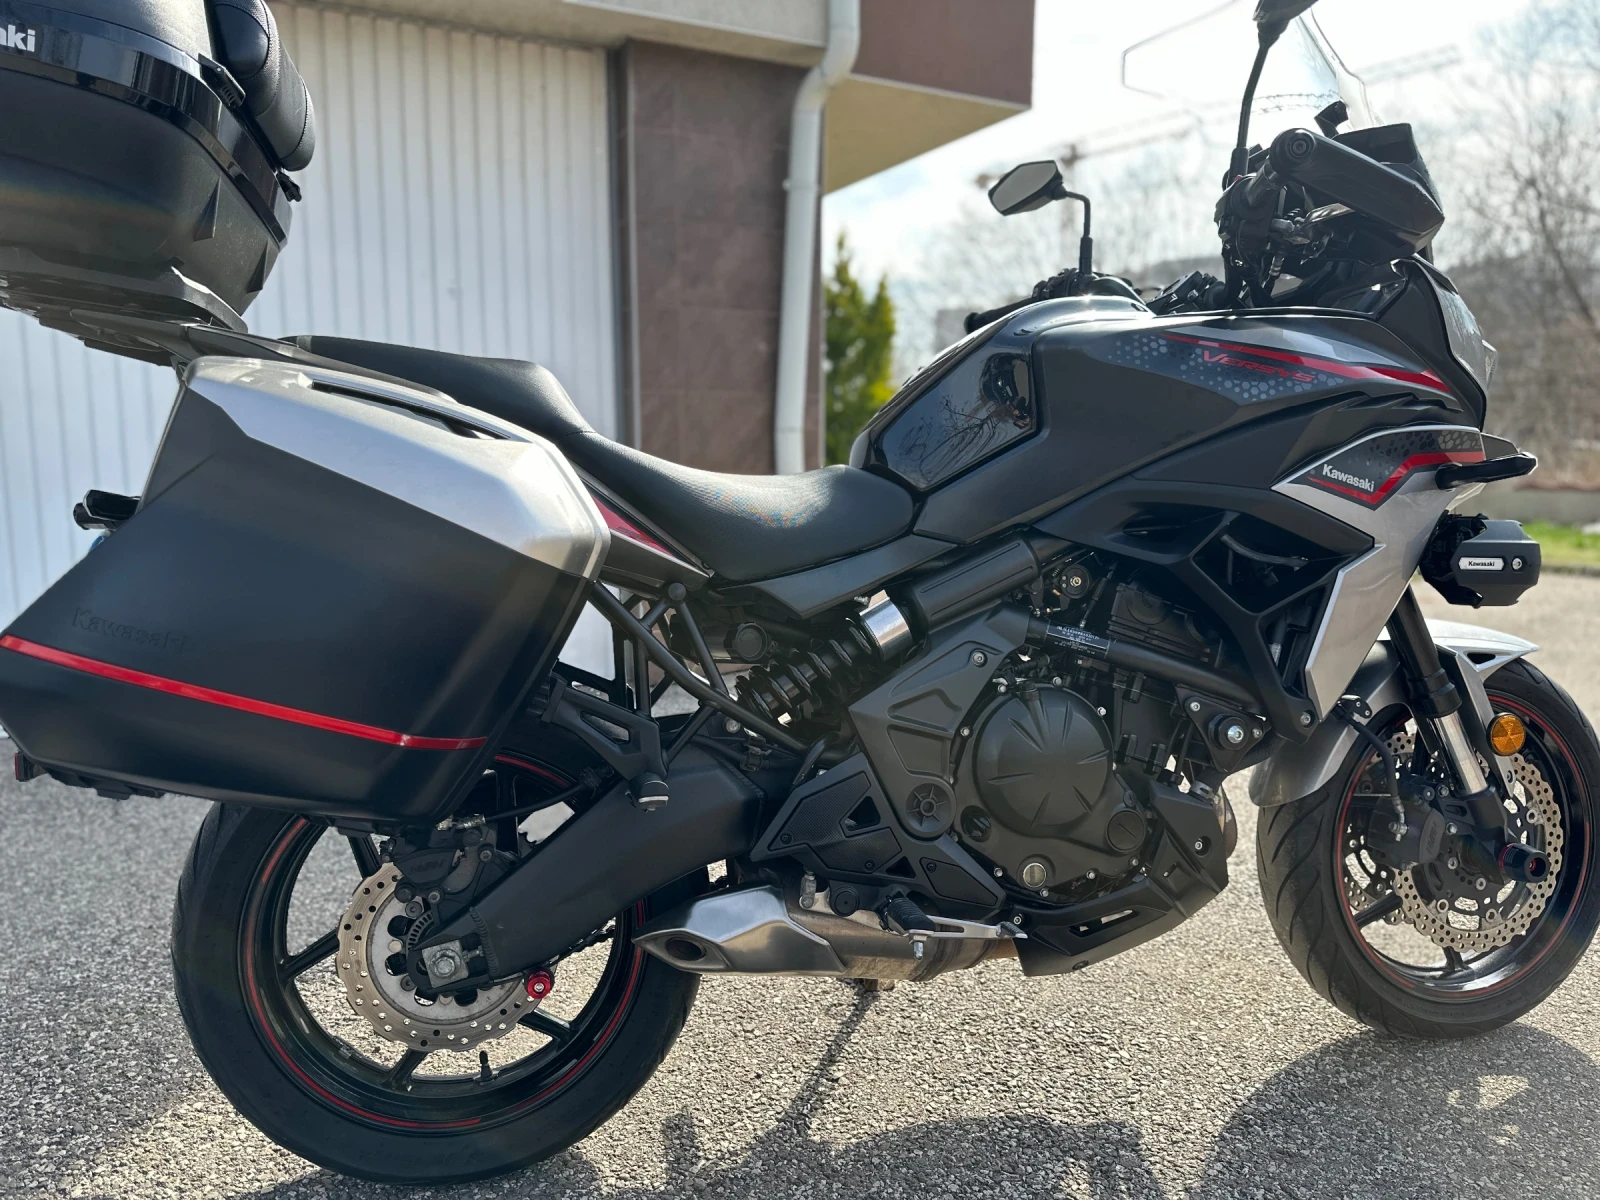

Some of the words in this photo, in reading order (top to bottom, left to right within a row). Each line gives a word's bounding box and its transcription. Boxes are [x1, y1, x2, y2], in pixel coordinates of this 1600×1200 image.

[1204, 350, 1315, 383] VERSYS
[1322, 463, 1375, 493] Kawasaki
[72, 607, 188, 654] Kawasaki
